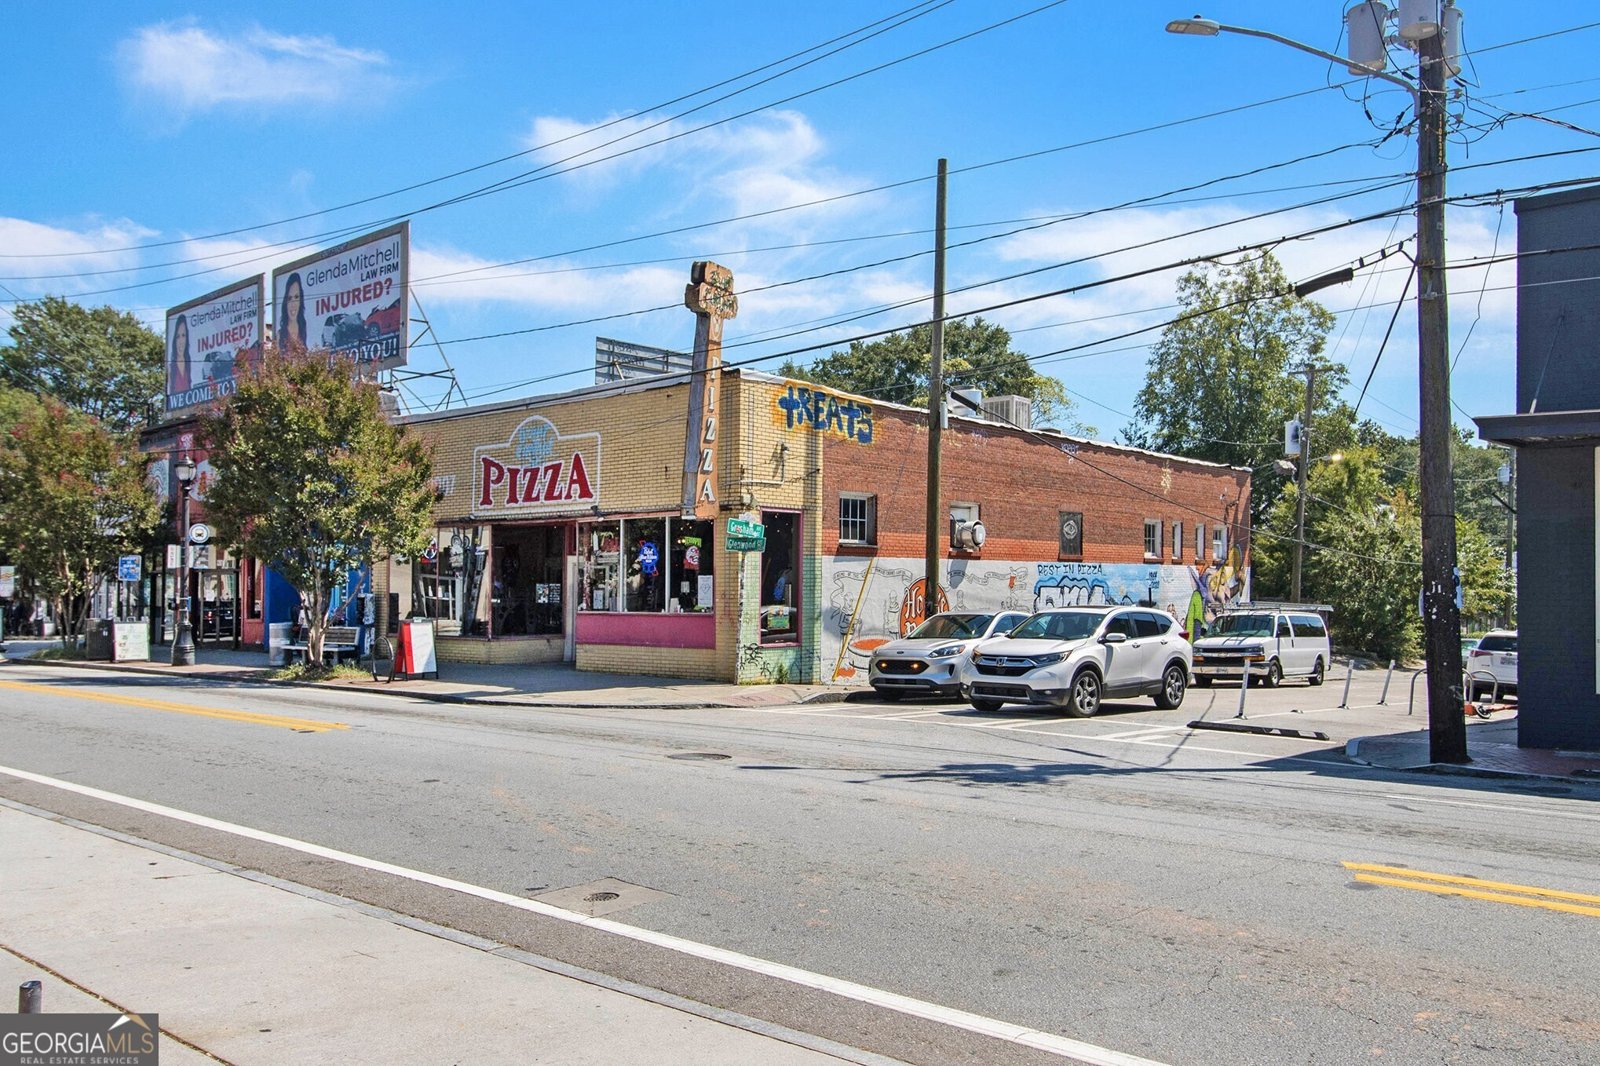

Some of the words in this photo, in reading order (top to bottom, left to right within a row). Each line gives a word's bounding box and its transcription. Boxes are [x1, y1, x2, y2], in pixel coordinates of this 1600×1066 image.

[360, 268, 378, 282] LAW
[379, 261, 400, 278] FIRM
[315, 277, 393, 317] INJURED?
[229, 314, 241, 326] LAW
[241, 308, 258, 323] FIRM
[197, 321, 253, 353] INJURED?
[361, 338, 397, 360] YOU!
[170, 393, 184, 409] WE
[185, 386, 214, 405] COME
[700, 355, 719, 502] PIZZA
[479, 452, 594, 507] PIZZA
[1037, 564, 1061, 577] REST
[1063, 563, 1075, 574] IN
[1077, 563, 1103, 576] PIZZA
